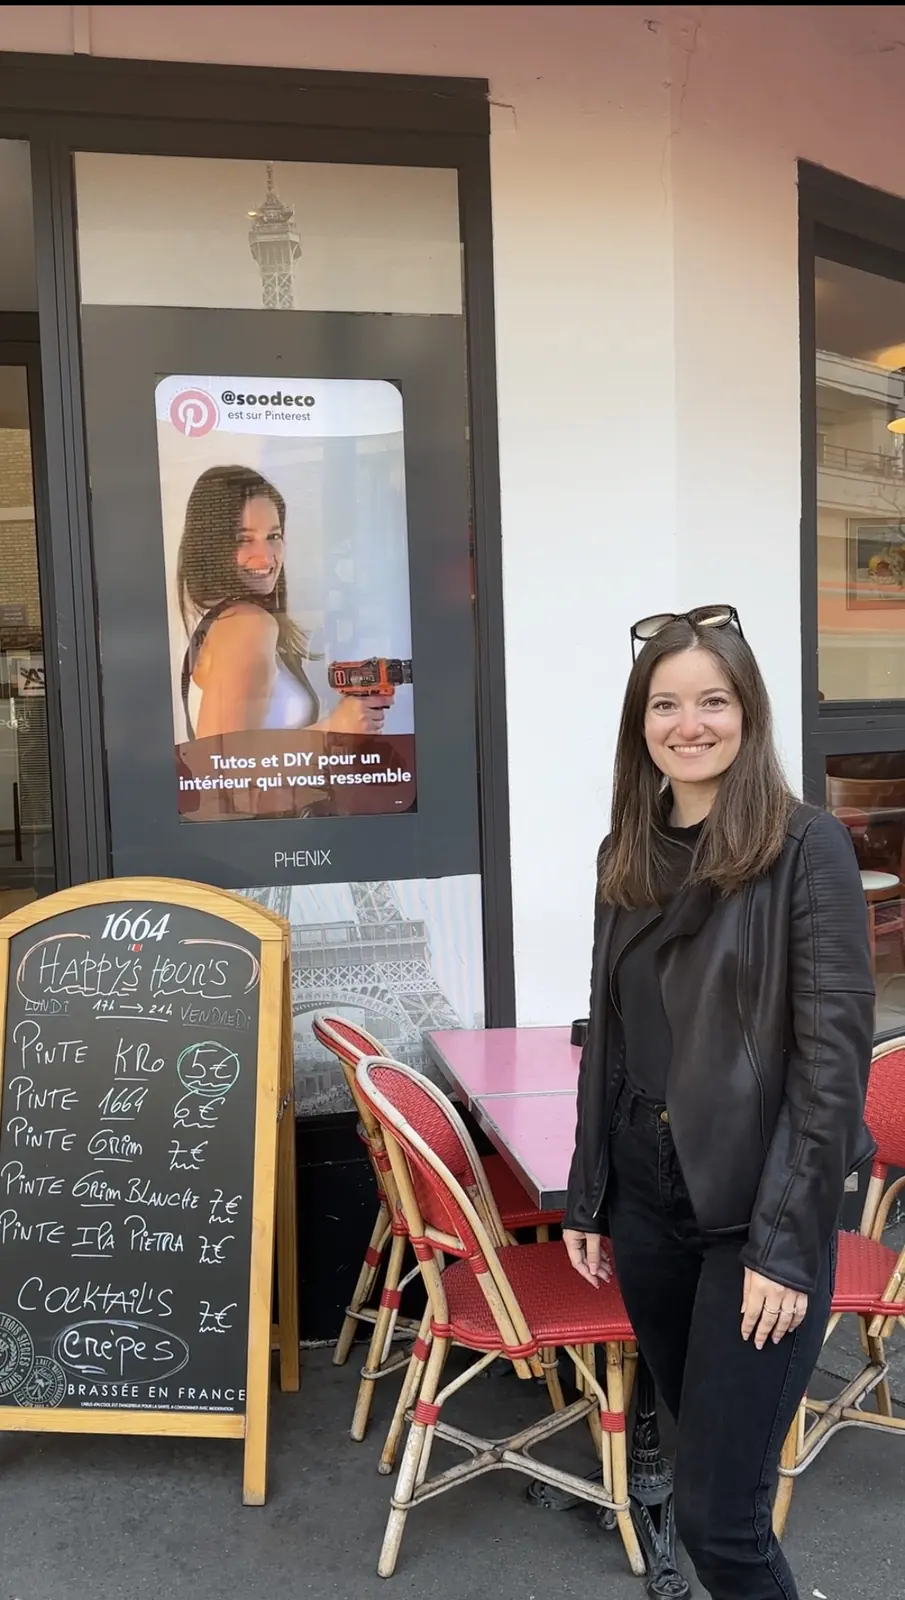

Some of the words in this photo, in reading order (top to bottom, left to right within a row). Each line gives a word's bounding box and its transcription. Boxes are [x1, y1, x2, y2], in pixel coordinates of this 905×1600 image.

[221, 390, 315, 406] @soodeco
[228, 411, 243, 420] est
[247, 412, 261, 420] sur
[265, 411, 310, 421] Pinterest
[211, 755, 255, 770] Tutos
[261, 755, 278, 768] et
[283, 752, 313, 767] DIY
[318, 753, 355, 770] pour
[361, 753, 380, 764] un
[179, 776, 251, 791] intérieur
[256, 773, 282, 793] qui
[286, 775, 325, 787] vous
[330, 767, 411, 785] ressemble
[274, 850, 331, 868] PHENIX
[101, 908, 171, 942] 1664
[98, 1087, 149, 1115] 1664
[68, 1383, 139, 1398] BRASSÉE
[149, 1386, 168, 1398] EN
[178, 1387, 246, 1401] FRANCE
